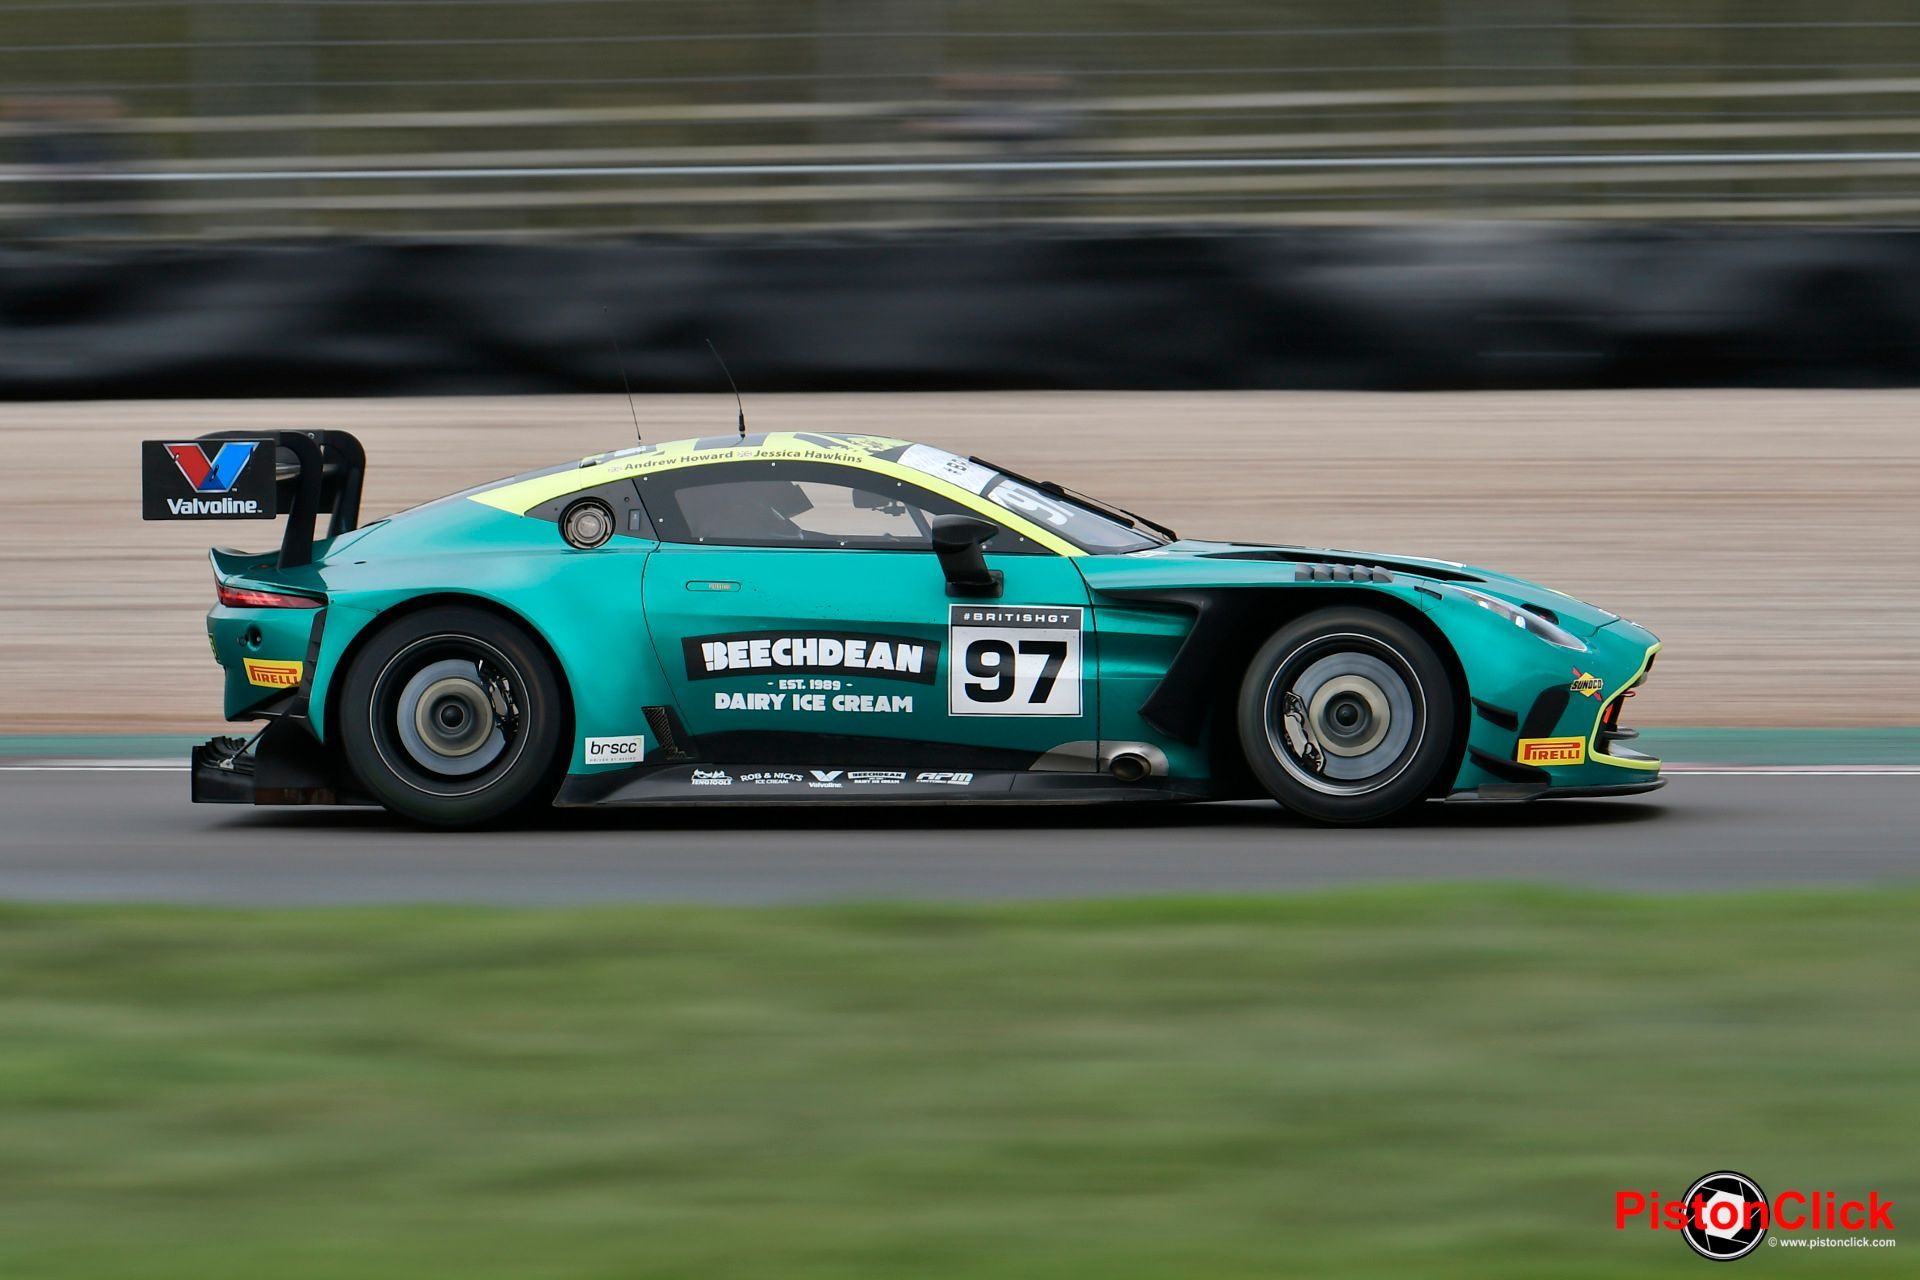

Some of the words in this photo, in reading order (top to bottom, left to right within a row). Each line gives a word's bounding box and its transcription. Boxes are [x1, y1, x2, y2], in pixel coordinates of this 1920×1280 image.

[623, 459, 677, 471] Andrew
[680, 450, 733, 463] Howard
[753, 450, 801, 459] Jessica
[804, 450, 863, 464] Hawkins
[166, 497, 257, 515] Valvoline
[963, 612, 1070, 623] #BRITISHGT
[701, 638, 924, 674] BEECHDEAN
[964, 639, 1068, 703] 97
[779, 679, 806, 690] EST.
[809, 679, 841, 690] 1989
[1571, 679, 1602, 690] SUNOCO
[714, 692, 786, 710] DAIRY
[792, 693, 826, 711] ICE
[832, 694, 913, 713] CREAM
[590, 740, 637, 755] brscc
[1524, 742, 1581, 761] PIRELLI
[740, 772, 762, 782] ROB
